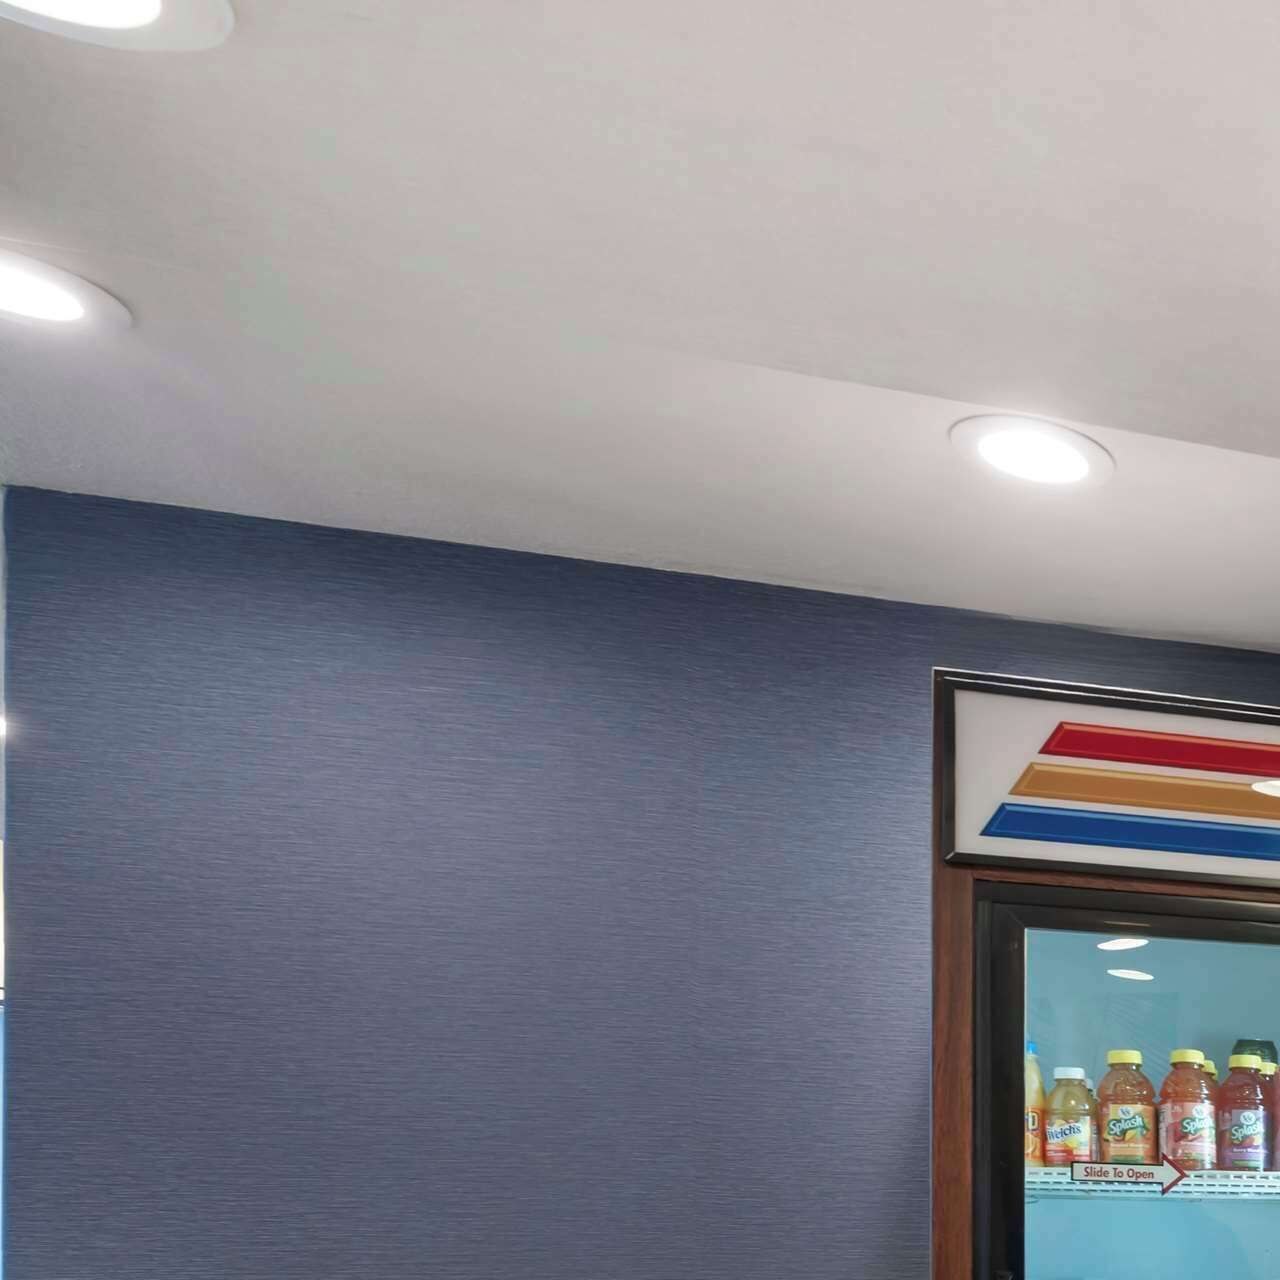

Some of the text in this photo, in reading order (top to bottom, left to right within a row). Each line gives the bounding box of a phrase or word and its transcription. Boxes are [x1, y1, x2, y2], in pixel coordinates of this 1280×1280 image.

[1107, 1113, 1145, 1135] Splash
[1083, 1166, 1155, 1182] Slide To Open
